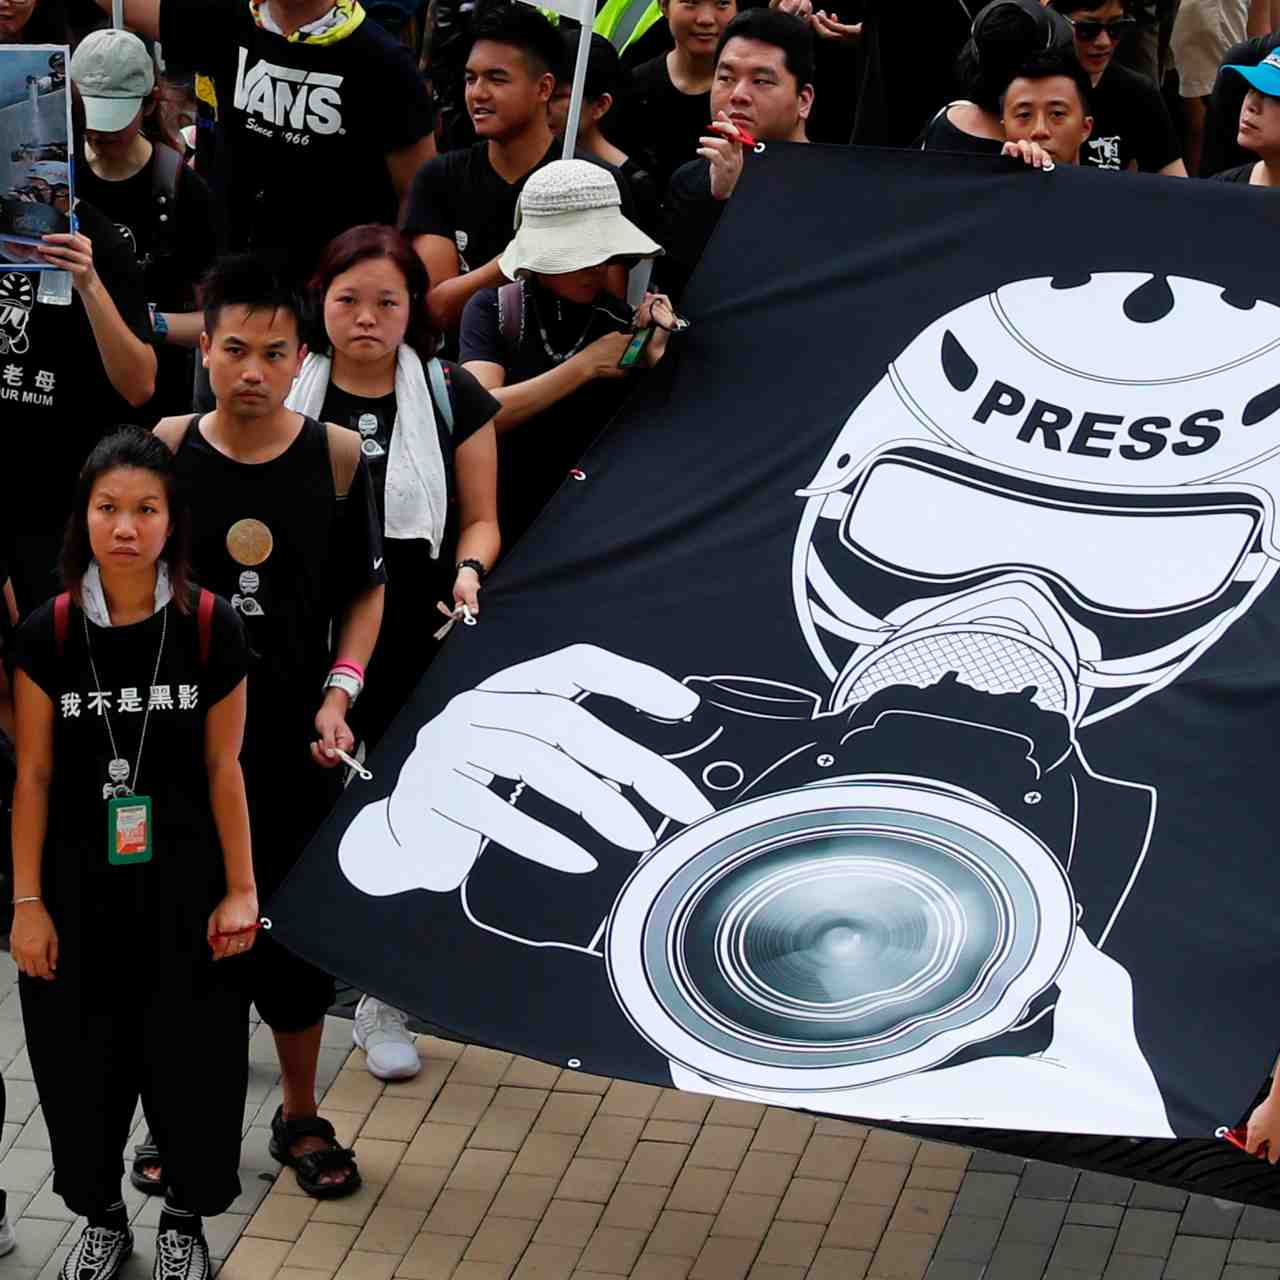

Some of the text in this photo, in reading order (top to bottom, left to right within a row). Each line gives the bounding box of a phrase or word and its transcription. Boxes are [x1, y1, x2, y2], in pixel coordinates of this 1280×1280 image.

[233, 45, 344, 136] VANS
[244, 117, 274, 139] Since
[21, 390, 55, 407] MUM
[971, 379, 1226, 462] PRESS
[60, 684, 200, 718] 我不是黑影
